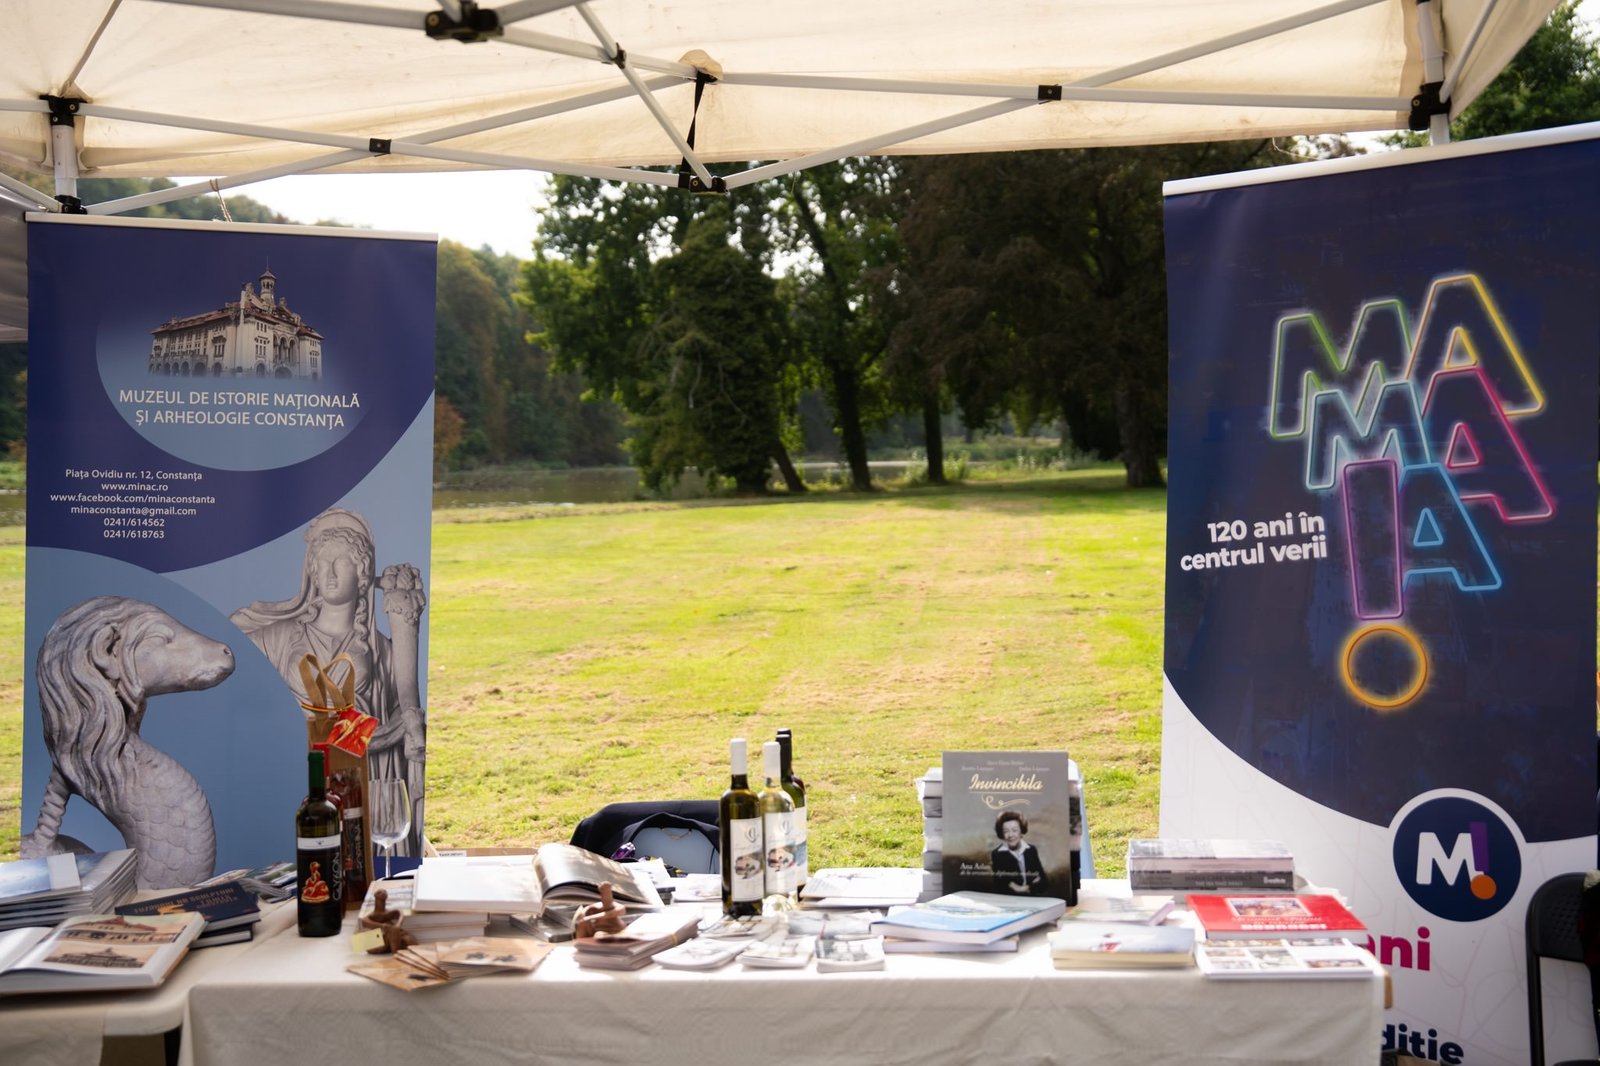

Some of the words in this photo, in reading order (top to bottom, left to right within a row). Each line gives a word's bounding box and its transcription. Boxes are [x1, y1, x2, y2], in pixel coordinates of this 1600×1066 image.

[119, 389, 185, 404] MUZEUL
[189, 391, 209, 405] DE
[213, 391, 270, 407] ISTORIE
[153, 410, 250, 426] ARHEOLOGIE
[91, 469, 123, 479] Ovidiu
[125, 471, 138, 479] nr.
[140, 470, 154, 480] 12,
[101, 482, 169, 492] www.minac.ro
[50, 493, 216, 504] www.facebook.com/minaconstanta
[70, 505, 197, 517] minaconstanta@gmail.com
[103, 517, 165, 527] 0241/614562
[1207, 519, 1248, 543] 120
[1253, 511, 1294, 539] ani
[1297, 511, 1326, 534] în
[103, 529, 165, 539] 0241/618763
[1180, 541, 1265, 571] centrul
[1269, 534, 1328, 562] verii
[968, 773, 1043, 791] Invincibila
[1367, 926, 1431, 971] ni
[1381, 1022, 1464, 1066] ditie
